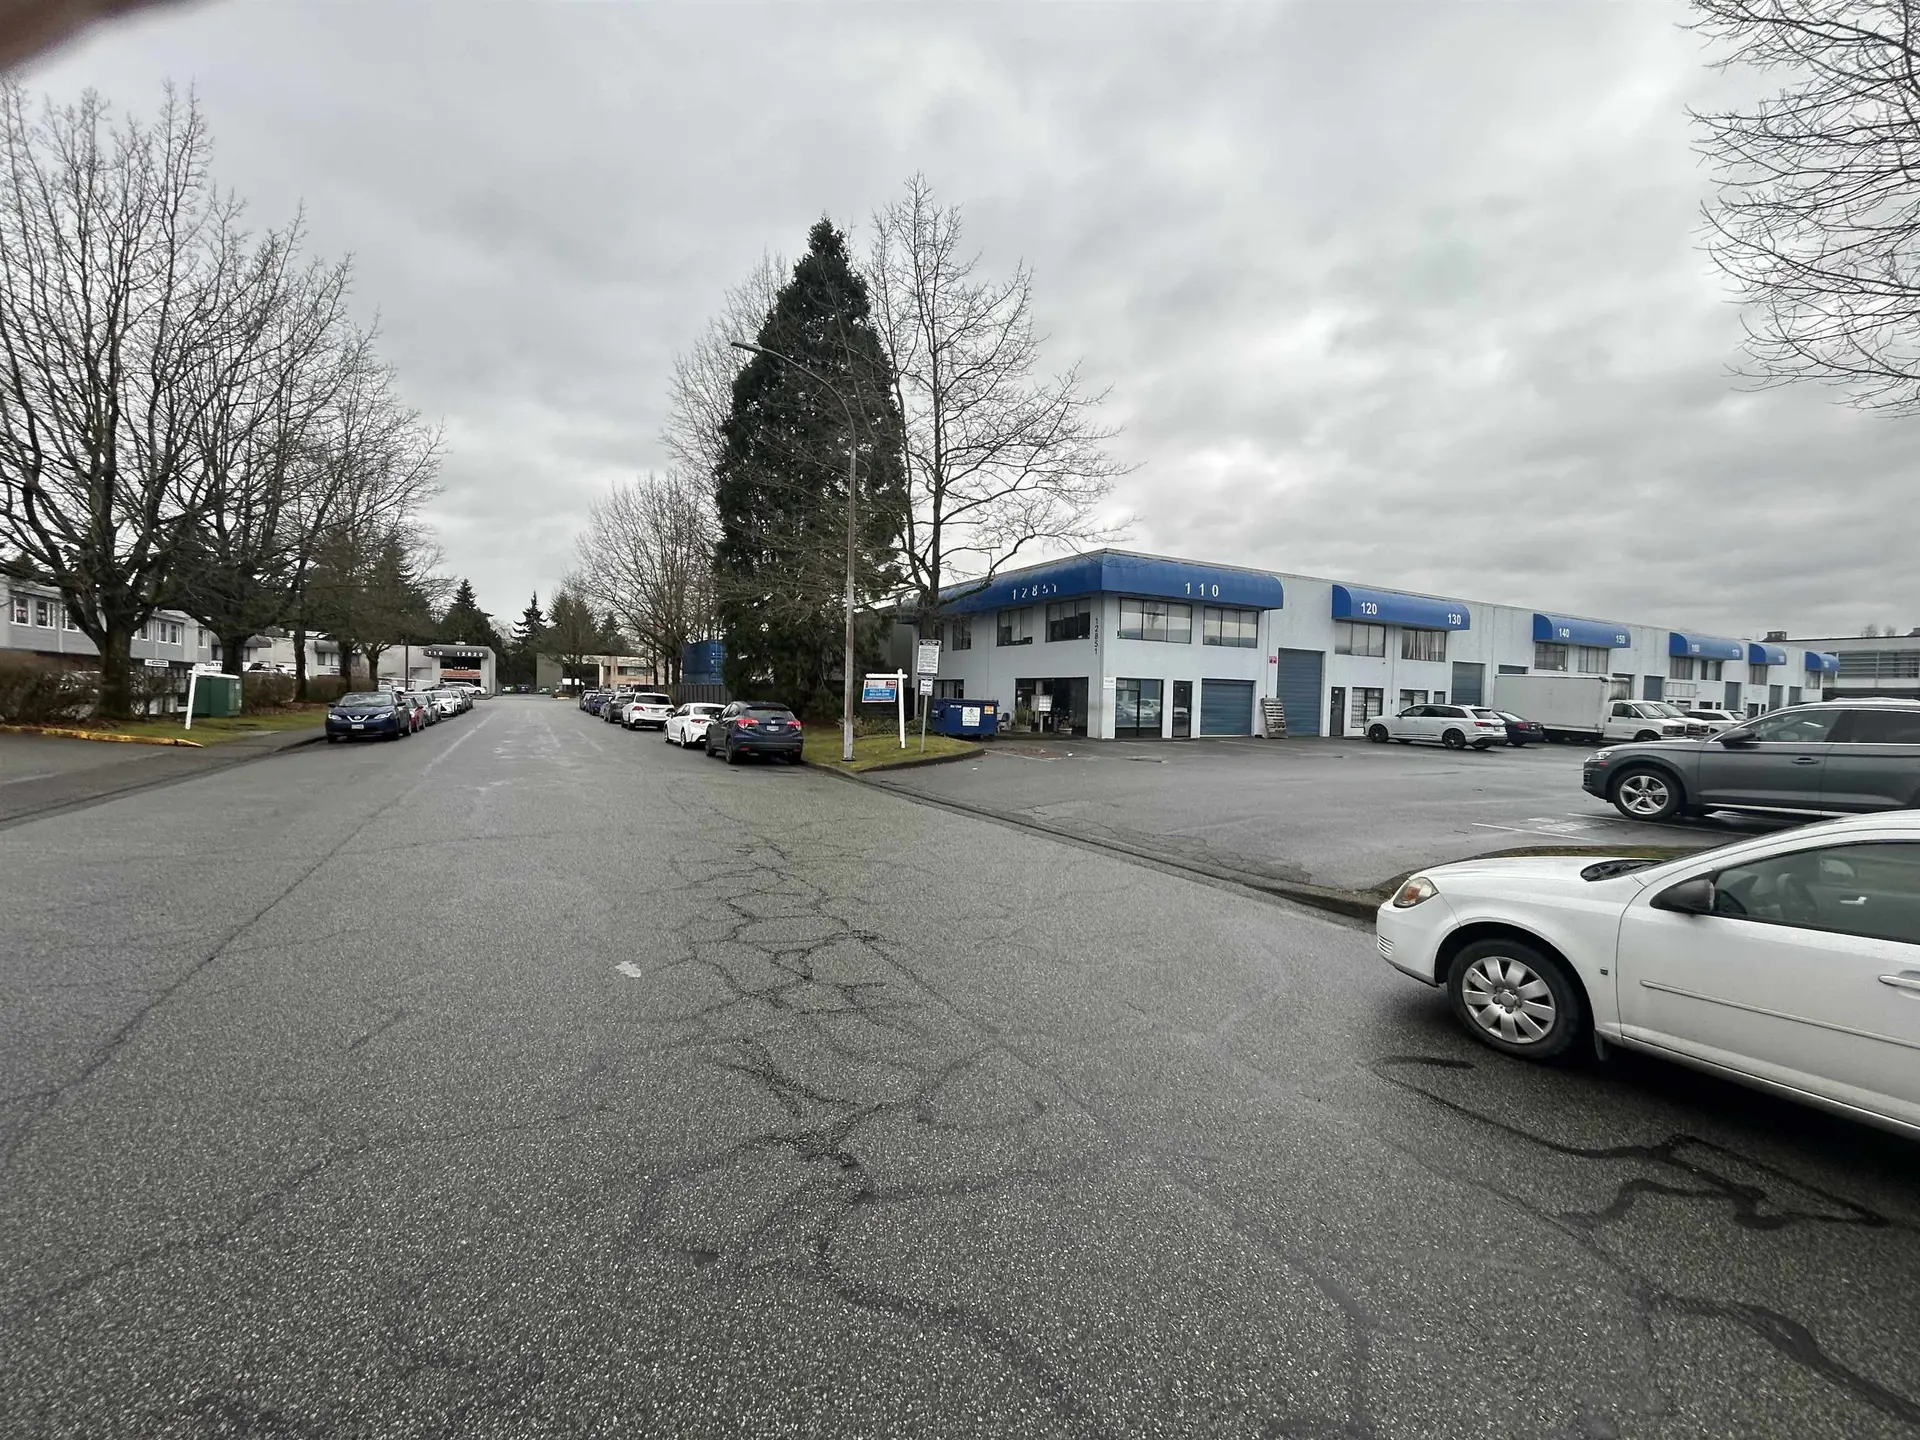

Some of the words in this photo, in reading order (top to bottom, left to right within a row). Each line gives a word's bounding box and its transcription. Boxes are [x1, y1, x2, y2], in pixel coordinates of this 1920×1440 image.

[1185, 582, 1219, 597] 110
[1361, 602, 1378, 615] 120
[1447, 613, 1462, 625] 130
[1559, 627, 1570, 638] 140
